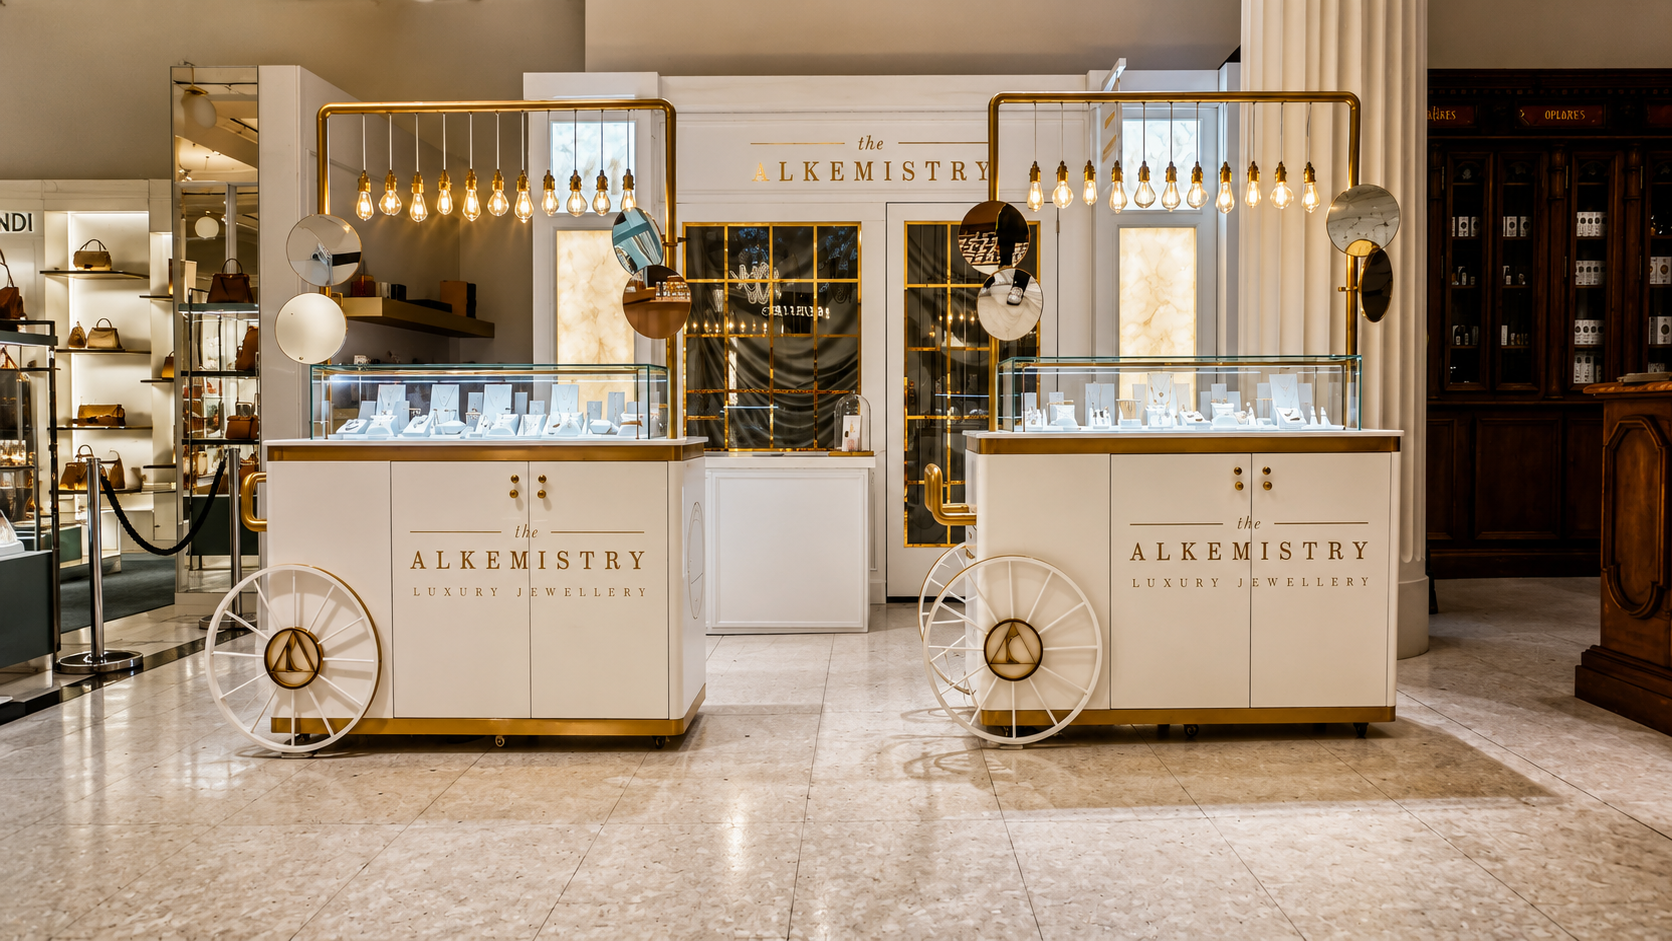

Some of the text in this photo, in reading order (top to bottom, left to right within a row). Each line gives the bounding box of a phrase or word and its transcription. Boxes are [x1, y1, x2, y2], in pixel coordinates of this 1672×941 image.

[858, 134, 884, 151] the
[752, 160, 989, 182] ALKEMISTRY
[0, 212, 33, 232] NDI
[514, 523, 539, 539] the
[1237, 515, 1261, 530] the
[1129, 541, 1369, 561] ALKEMISTRY
[410, 550, 646, 570] ALKEMISTRY
[1132, 576, 1370, 588] LUXURY JEWELLERY
[413, 586, 647, 598] LUXURY JEWELLERY
